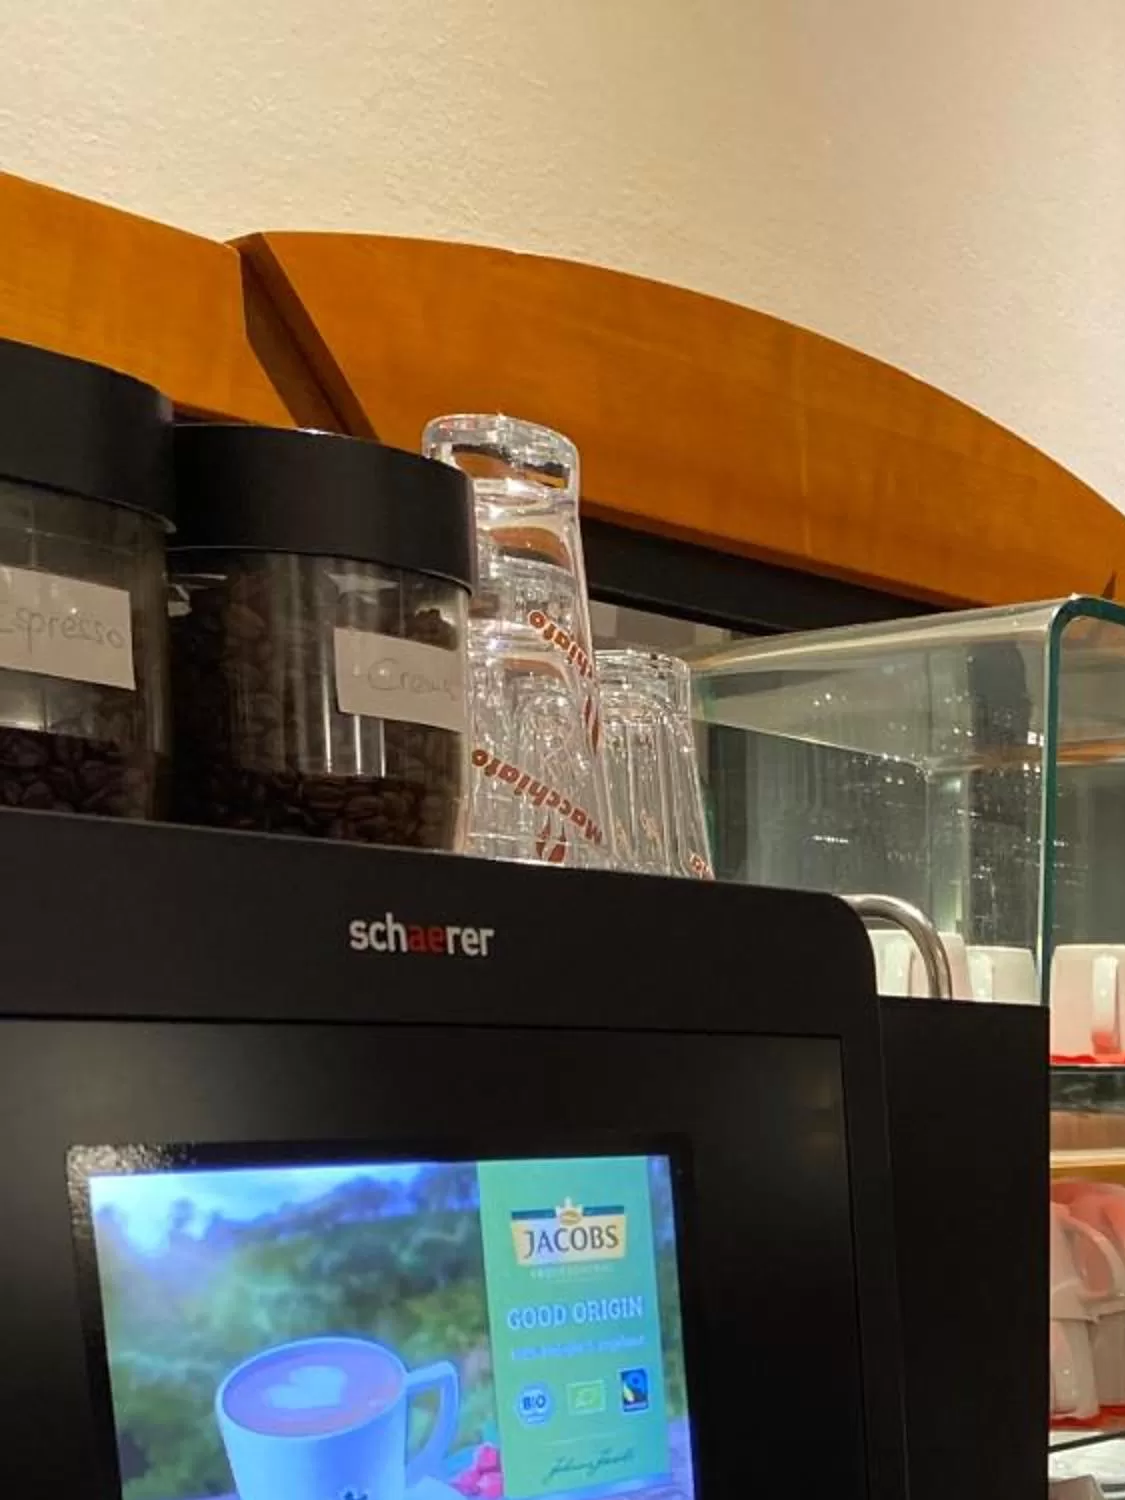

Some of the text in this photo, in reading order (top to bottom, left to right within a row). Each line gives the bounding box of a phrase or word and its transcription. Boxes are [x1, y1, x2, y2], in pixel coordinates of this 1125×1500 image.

[471, 748, 604, 845] Macchiato
[349, 911, 495, 957] schaerer
[523, 1225, 619, 1258] JACOBS
[506, 1295, 643, 1330] GOOD ORIGIN
